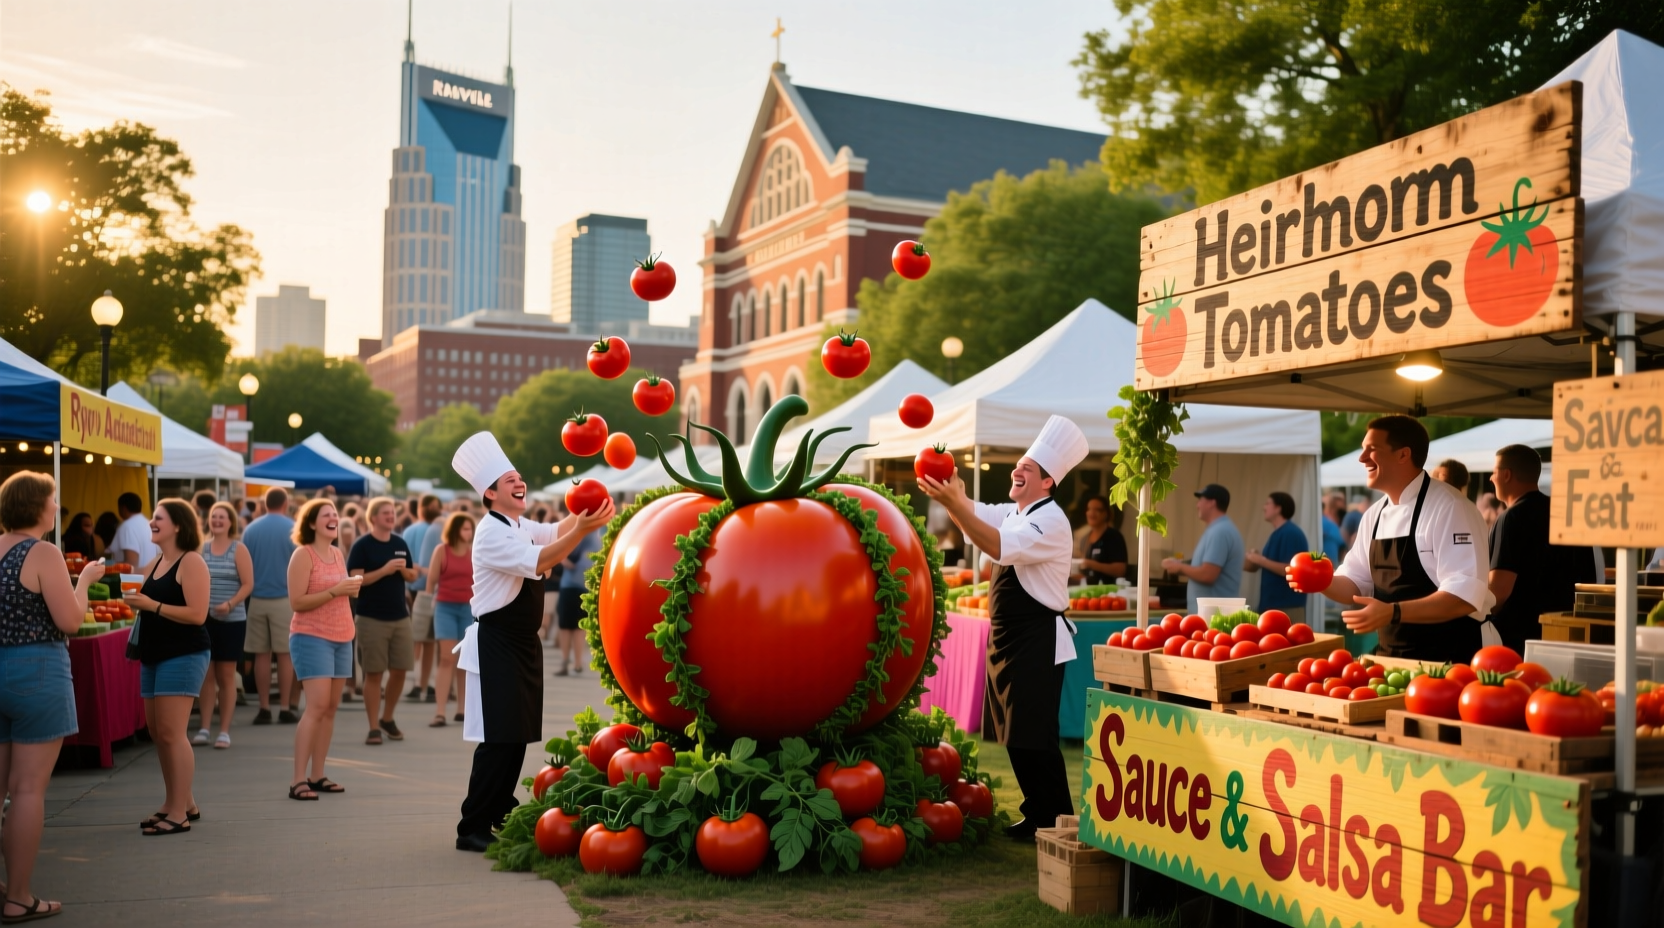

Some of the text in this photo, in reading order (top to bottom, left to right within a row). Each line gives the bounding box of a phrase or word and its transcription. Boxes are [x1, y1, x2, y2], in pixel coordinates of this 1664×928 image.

[1194, 259, 1453, 369] Tomatoes
[1096, 713, 1553, 928] Sauce & Salsa Bar
